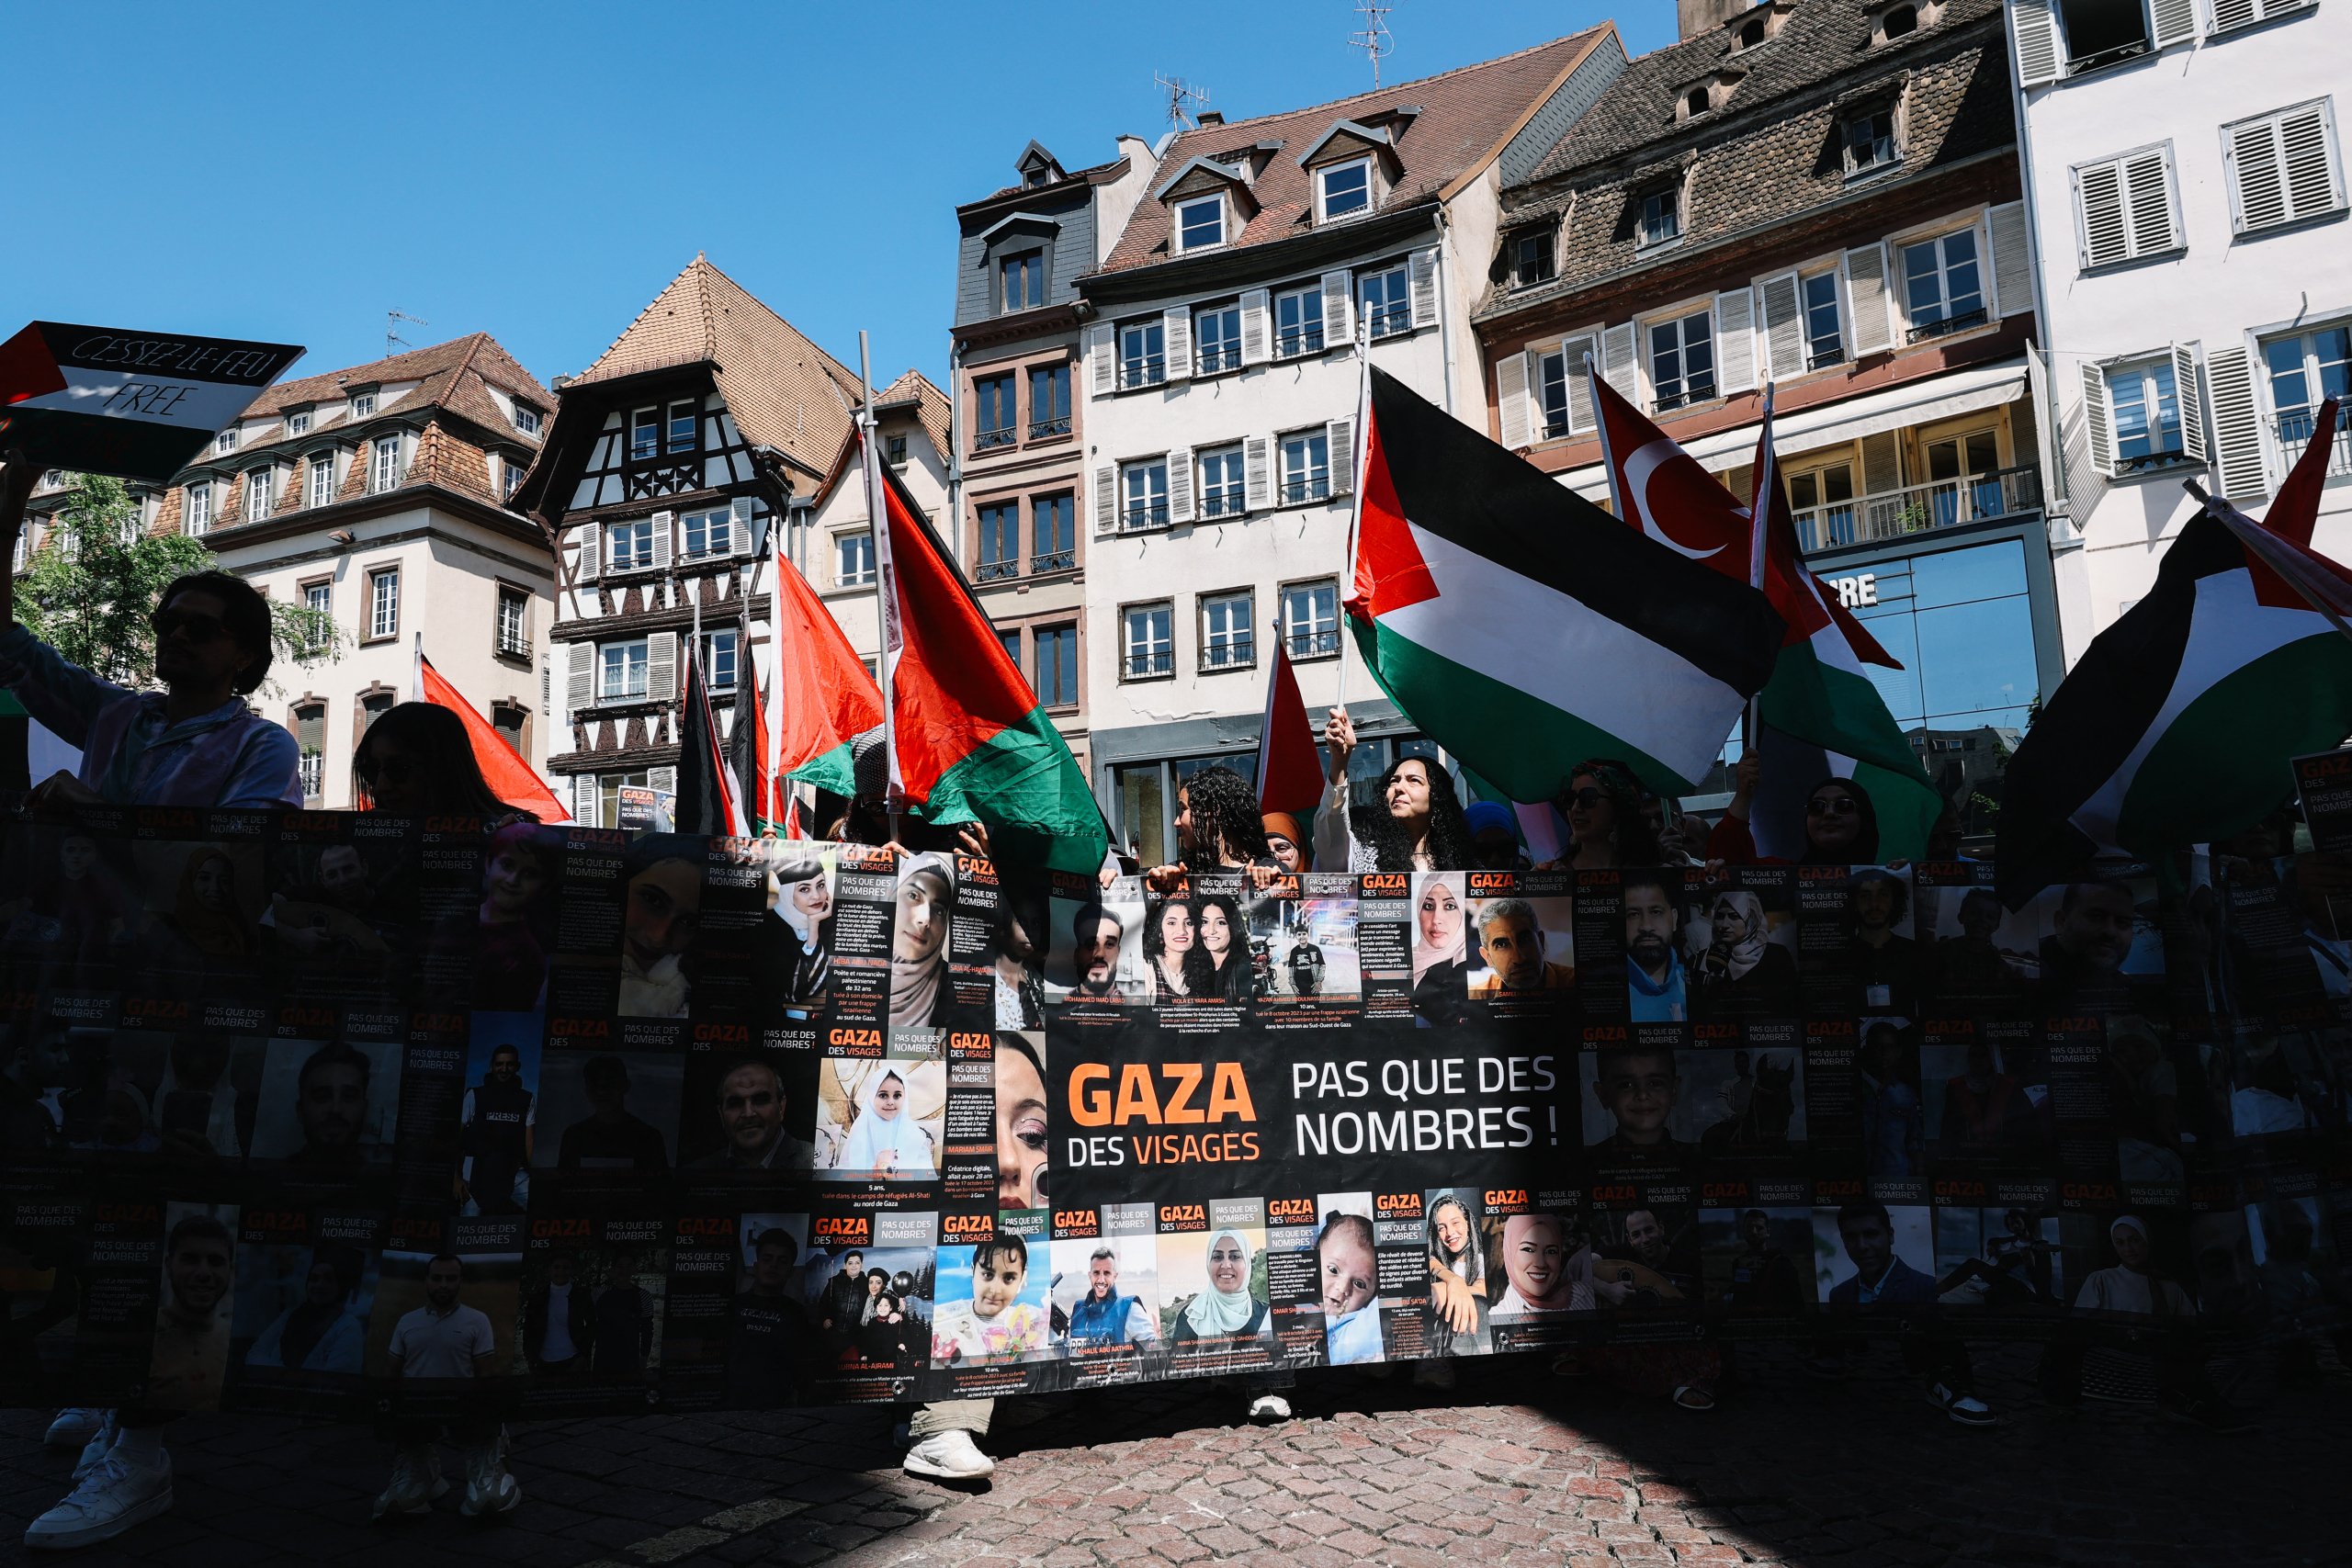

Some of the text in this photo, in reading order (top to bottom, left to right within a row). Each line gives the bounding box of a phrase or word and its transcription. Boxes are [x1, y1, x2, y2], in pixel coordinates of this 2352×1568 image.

[102, 382, 199, 416] FREE
[2304, 778, 2324, 788] DES
[622, 790, 655, 800] GAZA
[2310, 790, 2351, 803] PAS QUE
[569, 829, 626, 844] GAZA
[567, 841, 586, 850] DES
[842, 844, 894, 863] GAZA
[567, 857, 623, 869] PAS QUE DES
[842, 862, 894, 872] DES VISAGES
[957, 857, 998, 876] GAZA
[566, 867, 617, 879] NOMBRES
[1578, 871, 1621, 886] GAZA
[858, 878, 876, 886] QUE
[876, 879, 891, 887] DES
[958, 873, 1000, 886] DES VISAGES
[1363, 874, 1408, 889] GAZA
[841, 886, 886, 897] NOMBRES
[959, 887, 998, 899] PAS QUE DES
[957, 897, 995, 908] NOMBRES
[1377, 902, 1392, 910] QUE
[1577, 906, 1616, 914] NOMBRES
[2047, 1018, 2100, 1032] GAZA
[829, 1028, 882, 1047] GAZA
[894, 1033, 941, 1043] PAS QUE DES
[2047, 1032, 2064, 1041] DES
[828, 1046, 882, 1056] DES VISAGES
[894, 1043, 937, 1053] NOMBRES
[2067, 1046, 2084, 1055] QUE
[2051, 1055, 2098, 1063] NOMBRES
[1292, 1055, 1556, 1102] PAS QUE DES
[1068, 1062, 1257, 1127] GAZA
[487, 1111, 519, 1122] PRESS
[1295, 1105, 1533, 1156] NOMBRES
[1068, 1132, 1261, 1168] DES VISAGES
[1816, 1180, 1863, 1195] GAZA
[1889, 1183, 1905, 1191] QUE
[1377, 1193, 1421, 1211] GAZA
[96, 1204, 159, 1223] GAZA
[1377, 1209, 1422, 1219] DES VISAGES
[94, 1223, 115, 1232] DES
[815, 1218, 868, 1235] GAZA
[882, 1220, 932, 1229] PAS QUE DES
[1393, 1224, 1408, 1232] QUE
[1408, 1223, 1422, 1231] DES
[881, 1230, 926, 1239] NOMBRES
[1380, 1232, 1419, 1241] NOMBRES
[94, 1241, 155, 1250] PAS QUE DES
[814, 1236, 868, 1245] DES VISAGES
[93, 1251, 149, 1261] NOMBRES
